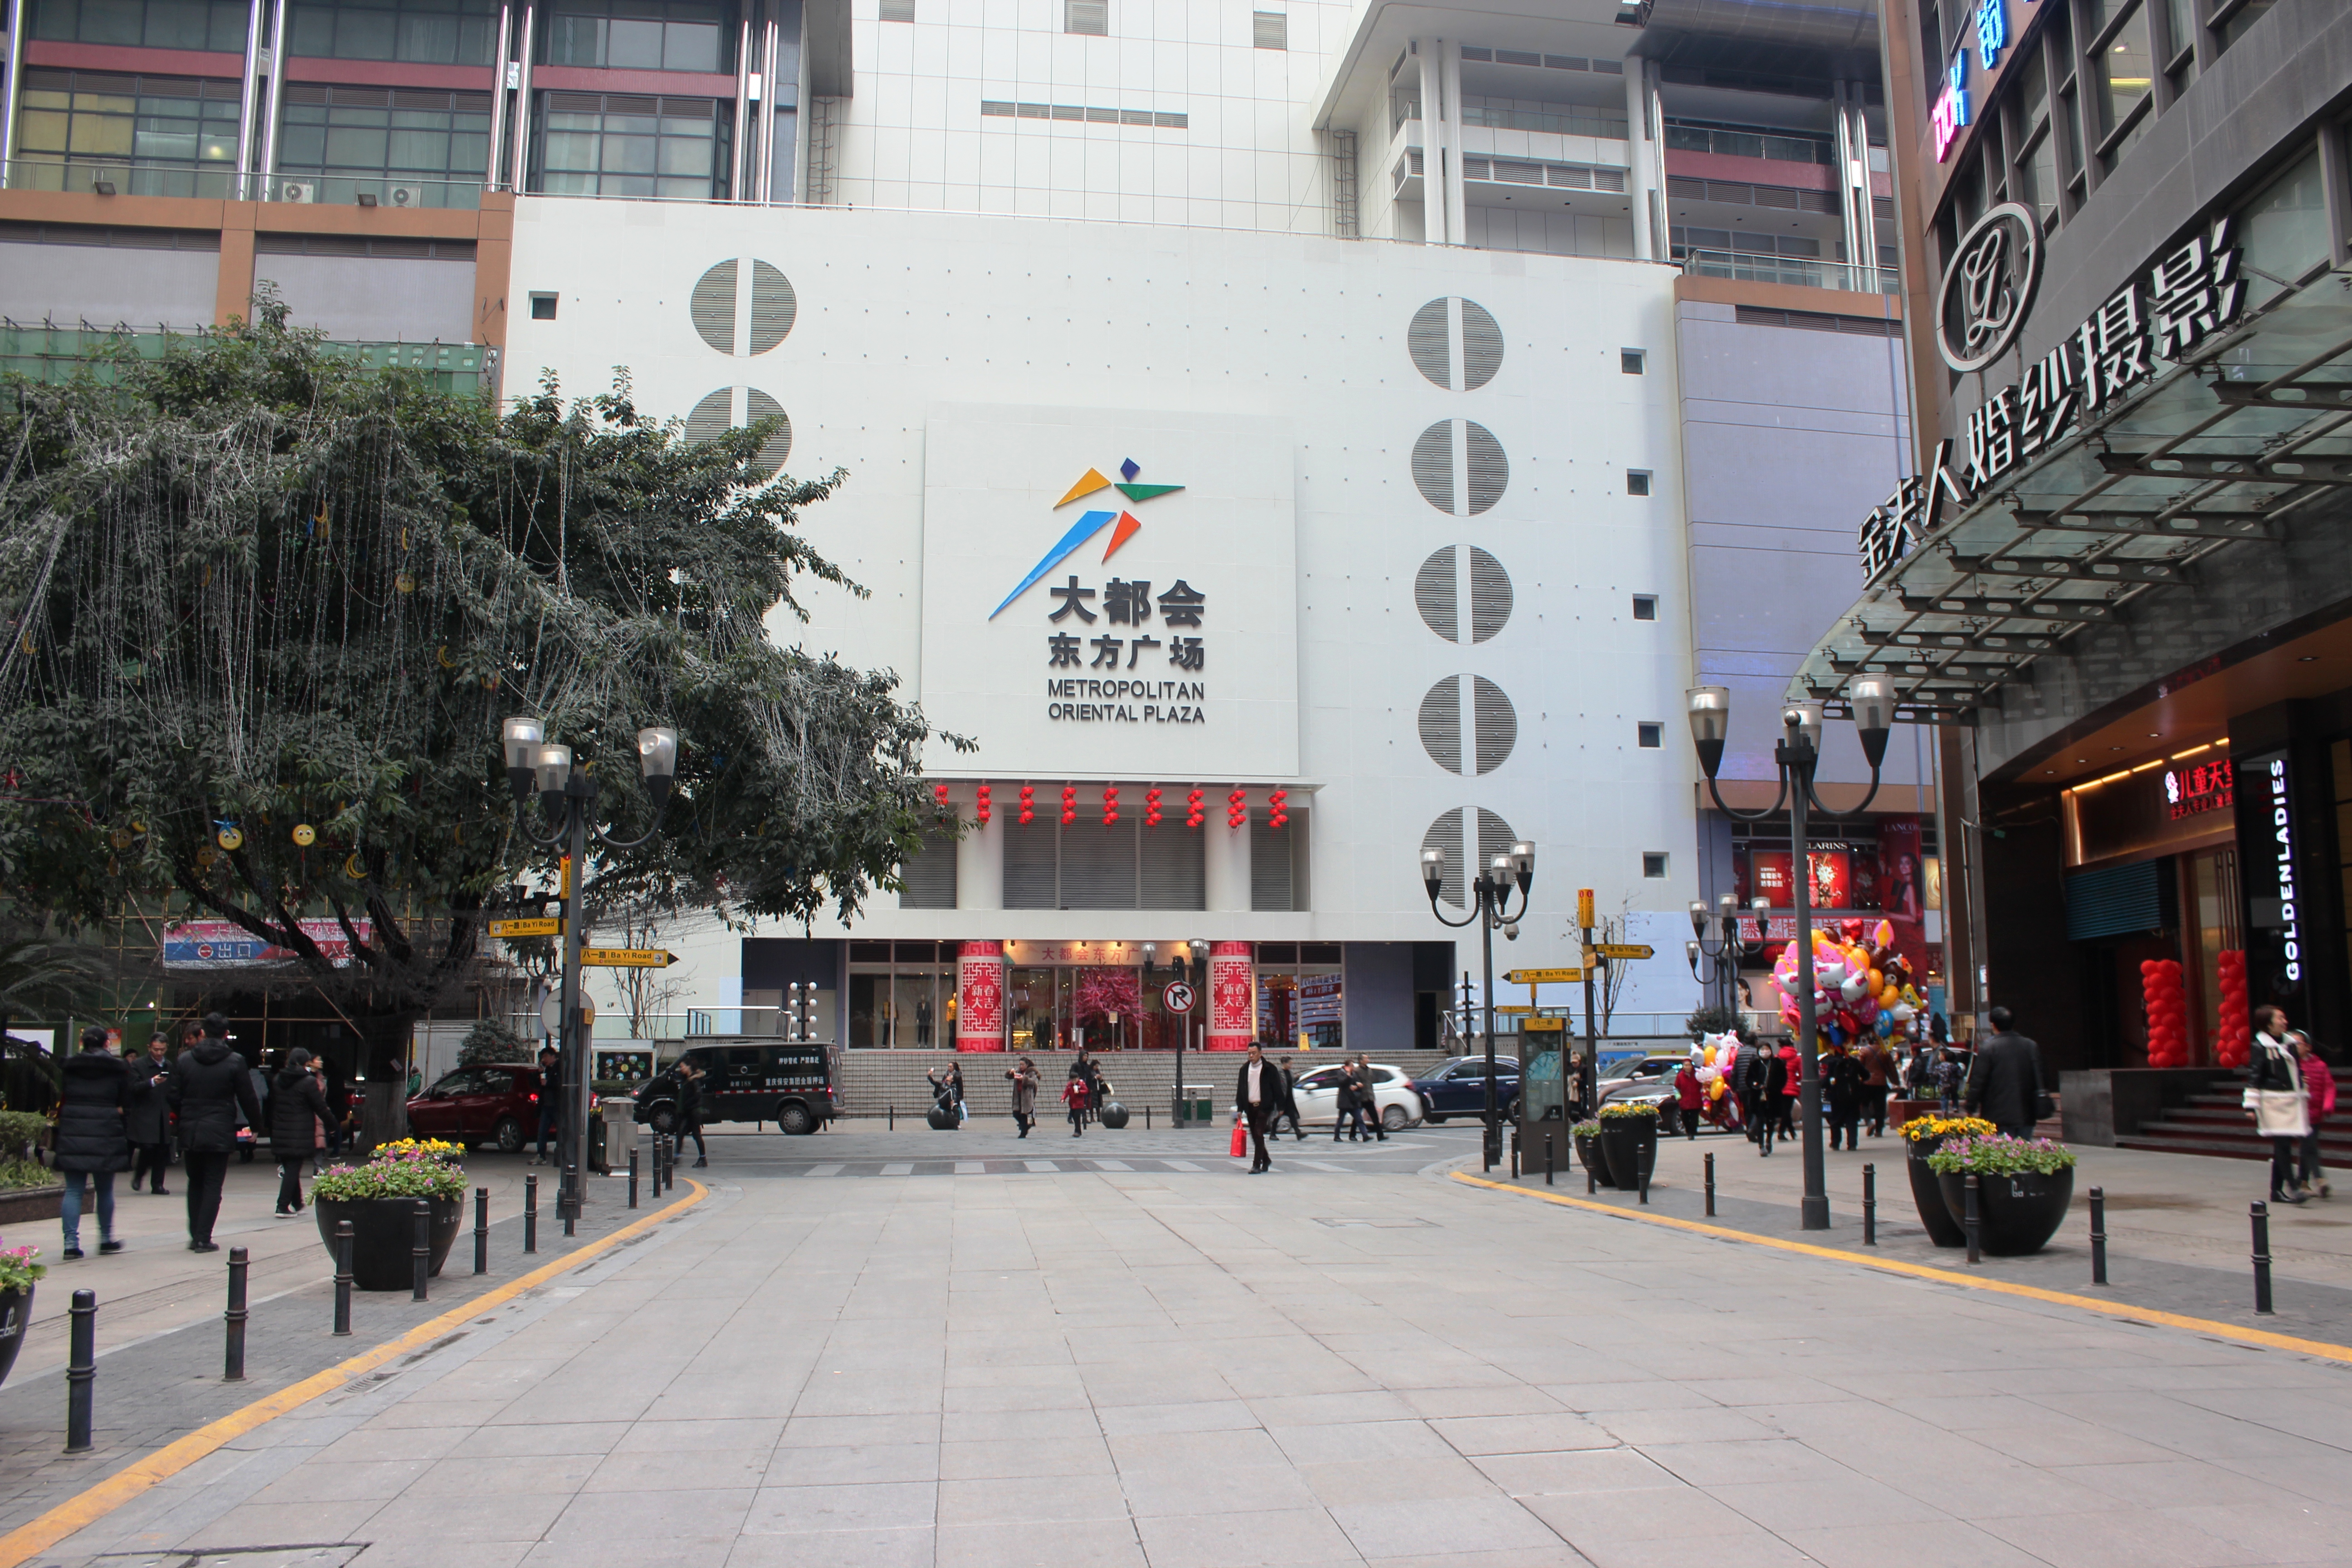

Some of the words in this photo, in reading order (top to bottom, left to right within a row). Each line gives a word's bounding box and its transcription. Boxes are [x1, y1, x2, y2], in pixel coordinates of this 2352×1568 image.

[1858, 214, 2246, 591] 金夫人婚纱摄影
[1048, 575, 1205, 627] 大都会
[1049, 632, 1204, 670] 东方广场
[1049, 679, 1204, 700] METROPOLITAN
[1049, 703, 1138, 721] ORIENTAL
[1144, 705, 1205, 723] PLAZA
[218, 944, 251, 958] 出口
[1042, 947, 1156, 961] 大都会东方广
[972, 985, 994, 996] 新春
[1223, 983, 1245, 995] 新春
[971, 997, 994, 1009] 大吉
[1223, 995, 1245, 1007] 大吉
